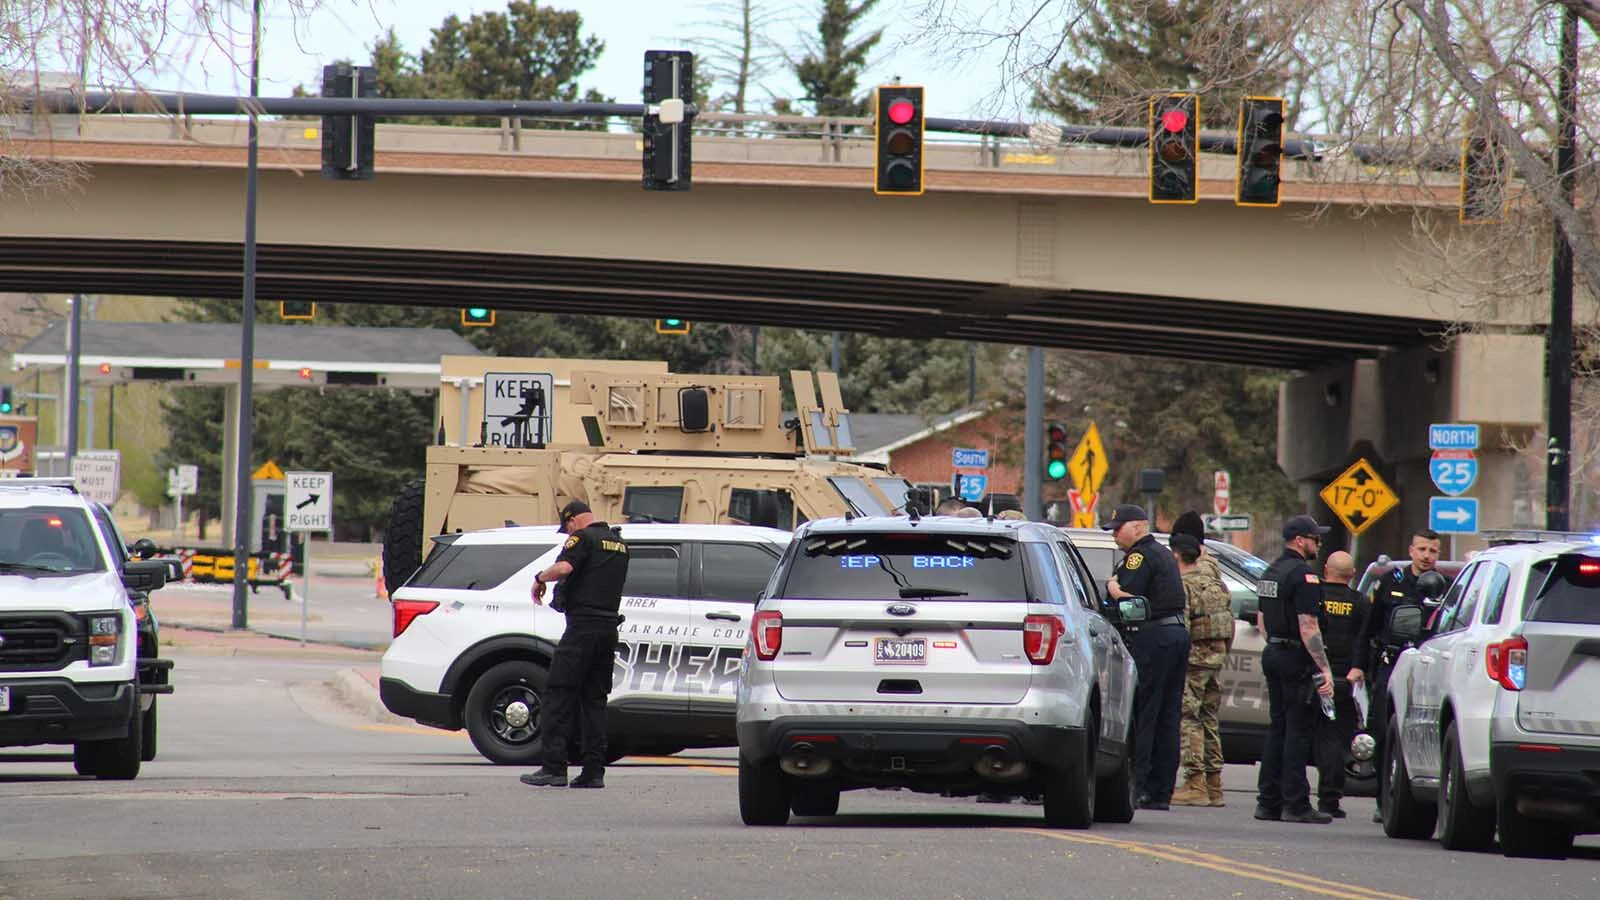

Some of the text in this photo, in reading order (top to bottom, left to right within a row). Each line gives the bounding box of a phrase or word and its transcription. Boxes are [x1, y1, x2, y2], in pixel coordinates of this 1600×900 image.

[495, 380, 541, 398] KEEP
[1432, 429, 1475, 445] NORTH
[955, 451, 987, 465] SOUTH
[1437, 462, 1471, 484] 25
[81, 476, 105, 486] MUST
[293, 478, 325, 489] KEEP
[960, 477, 982, 495] 25
[290, 514, 327, 526] RIGHT
[913, 555, 976, 568] BACK
[1257, 582, 1277, 596] POLICE
[1323, 600, 1353, 616] ERIFF
[618, 624, 745, 639] LARAMIE COU
[895, 643, 925, 657] 20409
